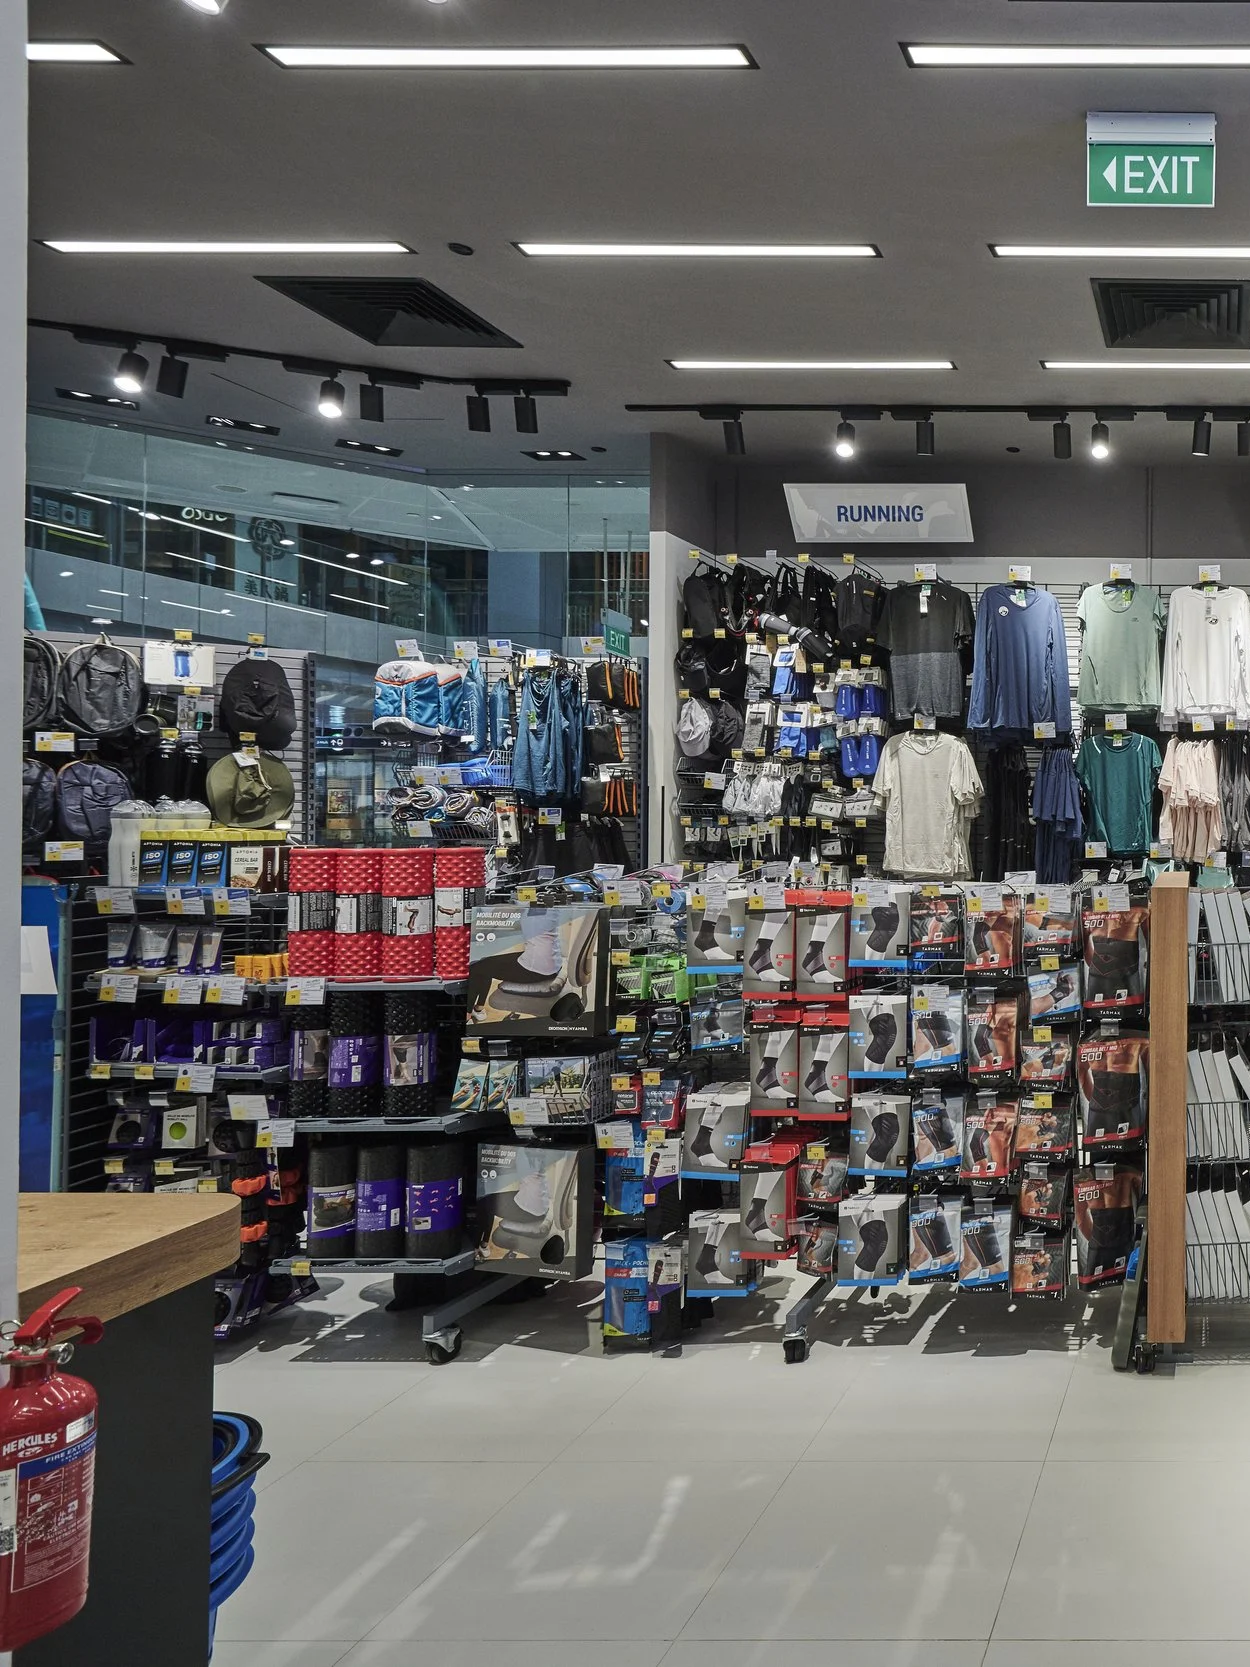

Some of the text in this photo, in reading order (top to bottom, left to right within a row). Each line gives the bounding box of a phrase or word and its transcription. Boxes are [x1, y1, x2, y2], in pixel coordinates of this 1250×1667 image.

[1124, 155, 1200, 194] EXIT
[836, 504, 924, 523] RUNNING
[610, 629, 626, 650] EXIT
[145, 851, 161, 860] ISO
[176, 851, 191, 860] ISO
[204, 852, 219, 861] ISO
[476, 911, 501, 919] MOBILITÉ
[967, 916, 985, 924] 500
[1084, 919, 1103, 929] 500
[968, 1017, 988, 1026] 500
[1080, 1051, 1103, 1062] 500
[966, 1120, 985, 1129] 500
[1078, 1190, 1100, 1201] 500
[2, 1432, 58, 1456] HERCULES
[45, 1451, 66, 1463] FIRE
